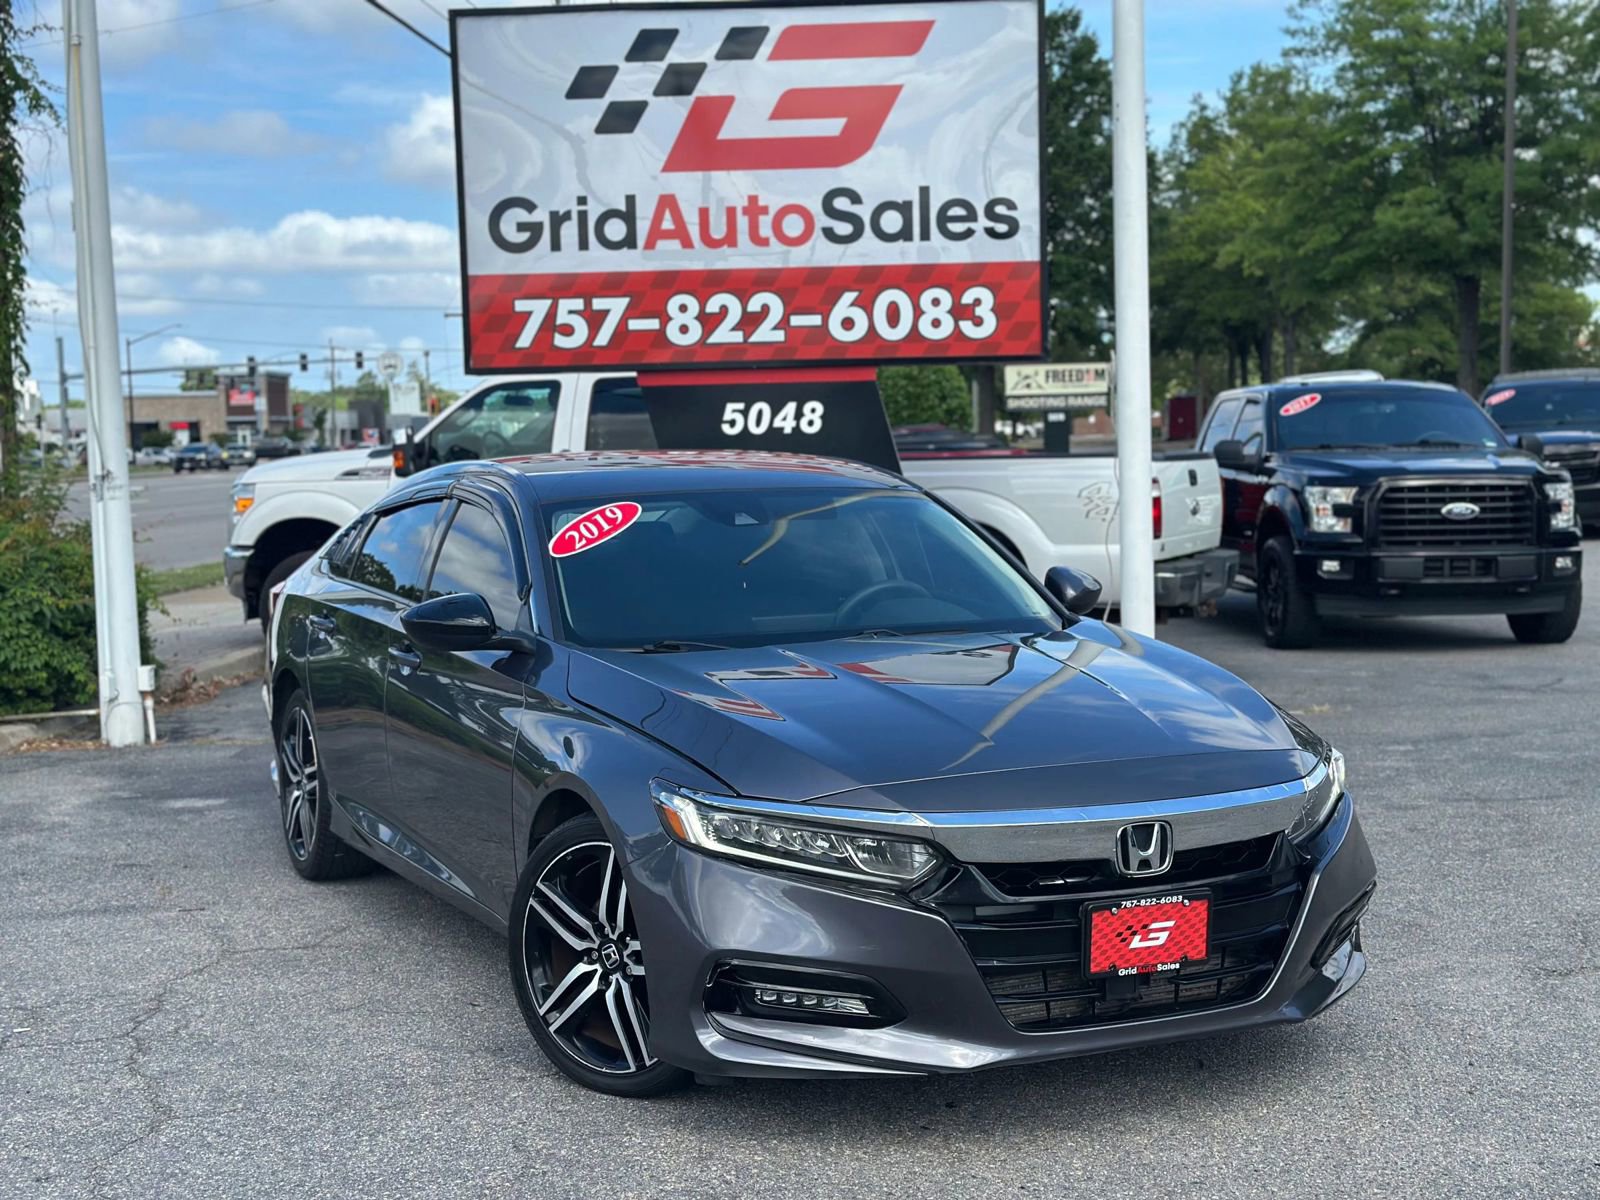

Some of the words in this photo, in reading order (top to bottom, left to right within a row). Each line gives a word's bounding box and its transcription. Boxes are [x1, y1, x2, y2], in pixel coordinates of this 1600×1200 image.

[488, 185, 1020, 254] GridAutoSales
[513, 286, 998, 349] 757-822-6083
[721, 400, 824, 435] 5048
[565, 506, 623, 549] 2019
[1120, 895, 1183, 909] 757-822-6083
[1118, 962, 1180, 976] GridAutoSales
